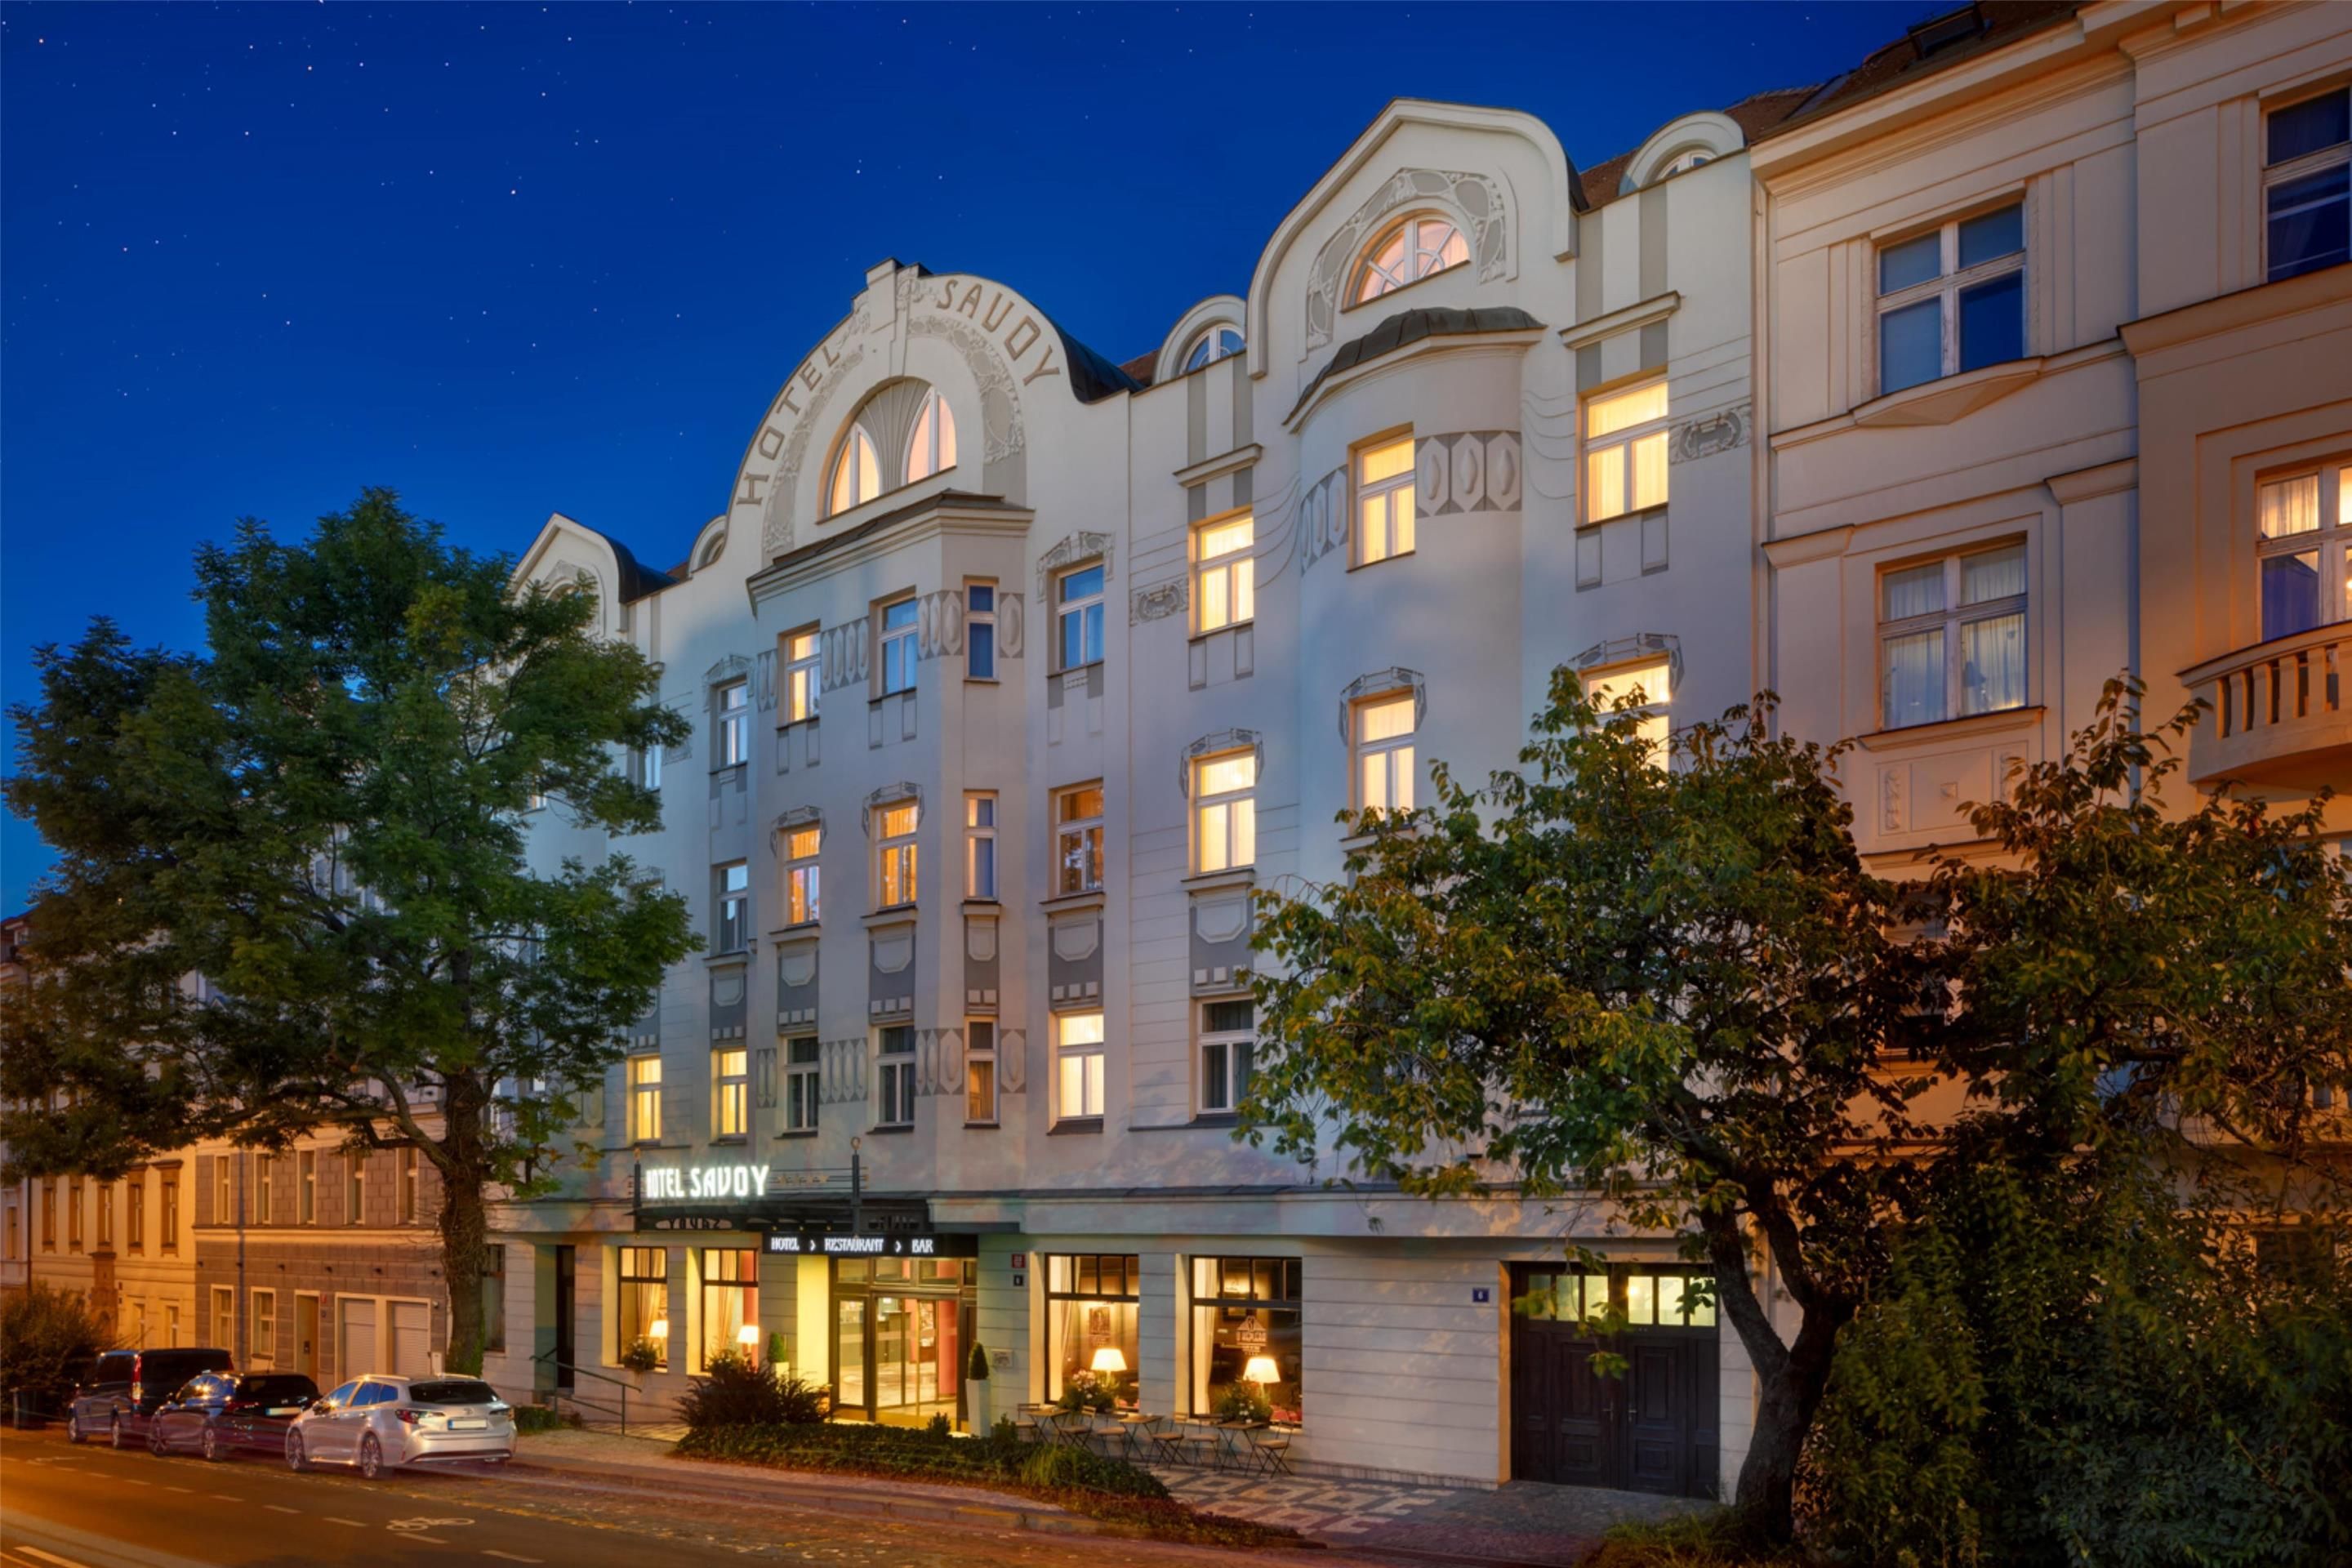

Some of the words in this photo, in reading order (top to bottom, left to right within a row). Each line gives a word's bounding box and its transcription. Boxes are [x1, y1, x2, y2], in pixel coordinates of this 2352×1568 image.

[736, 345, 840, 506] HOTEL
[936, 278, 1060, 386] SAVOY
[689, 1165, 769, 1197] SAVOY
[771, 1237, 800, 1250] HOTEL
[824, 1238, 884, 1252] RESTAURANT
[911, 1239, 933, 1253] BAR
